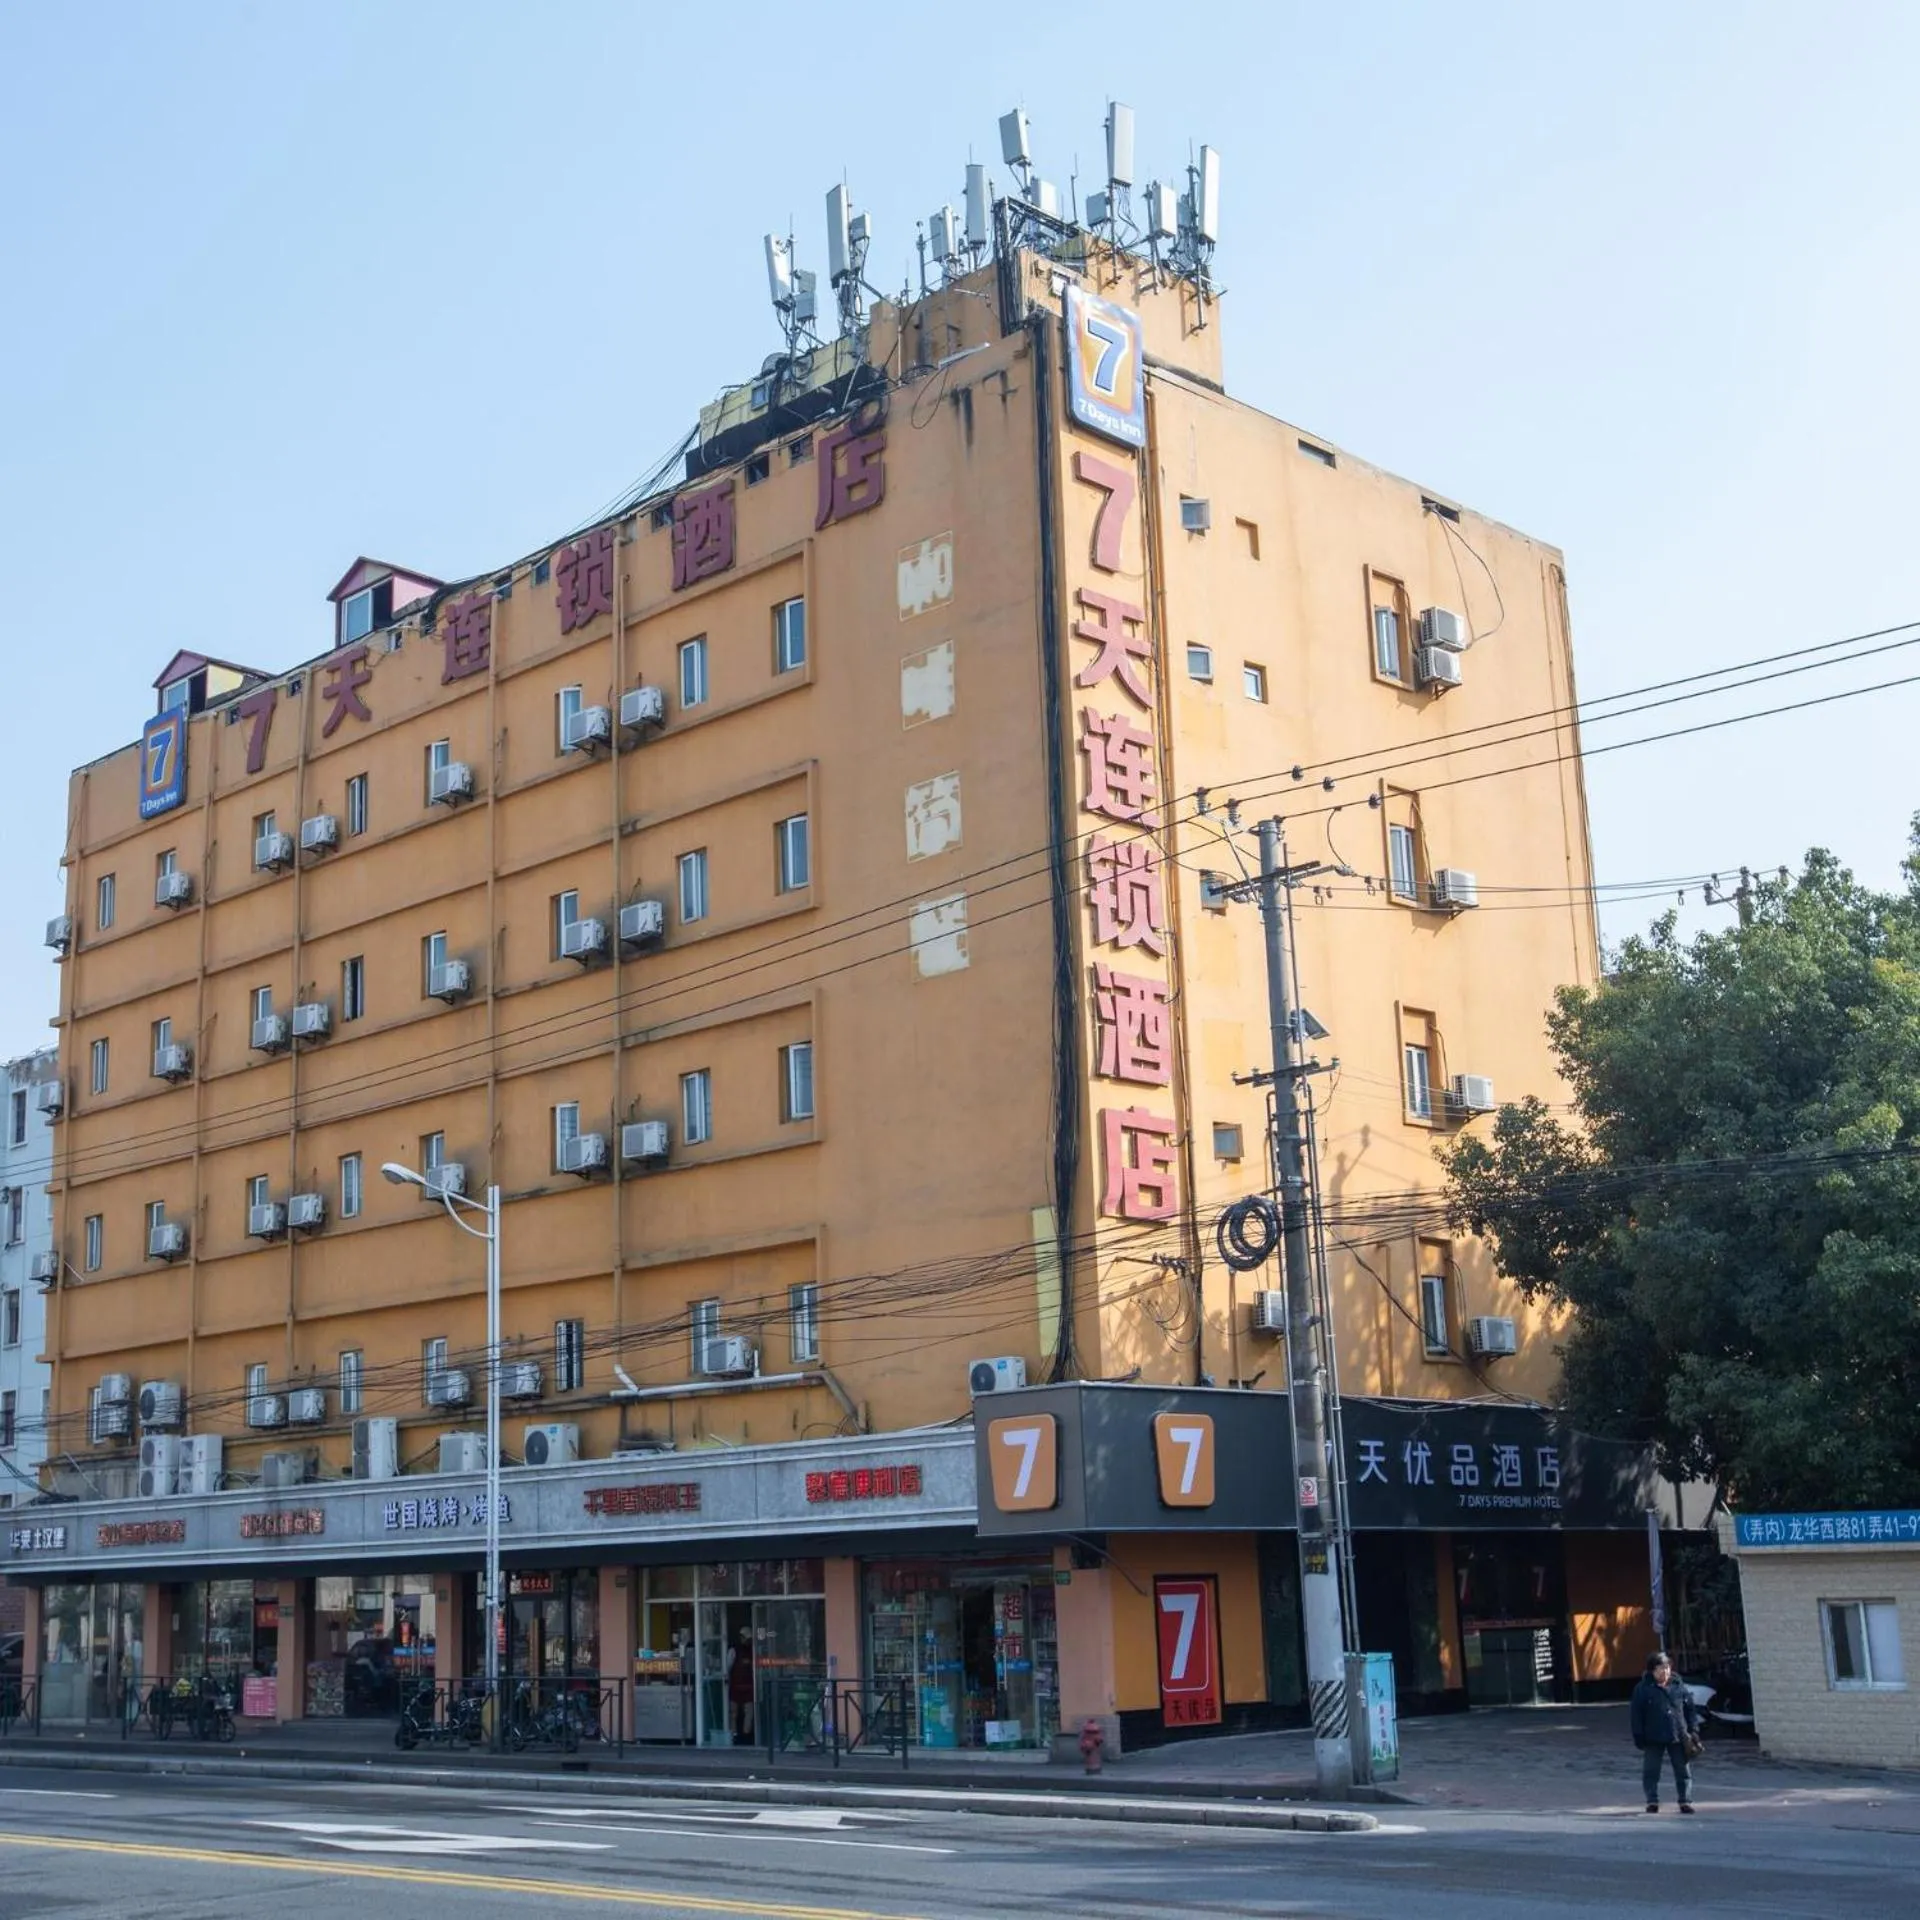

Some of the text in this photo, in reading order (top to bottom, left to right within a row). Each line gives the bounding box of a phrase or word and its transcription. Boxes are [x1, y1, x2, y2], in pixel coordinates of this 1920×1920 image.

[1085, 316, 1128, 397] 7
[1078, 398, 1142, 438] 7 Days Inn
[240, 412, 886, 774] 7天连锁酒店
[148, 726, 174, 788] 7
[1074, 450, 1184, 1223] 7天连锁酒店
[1003, 1428, 1042, 1498] 7
[1169, 1428, 1204, 1494] 7
[1459, 1494, 1466, 1508] 7
[1467, 1496, 1492, 1508] DAYS
[1493, 1495, 1532, 1509] PREMIUM
[1002, 1593, 1024, 1659] 超市
[1159, 1593, 1200, 1680] 7
